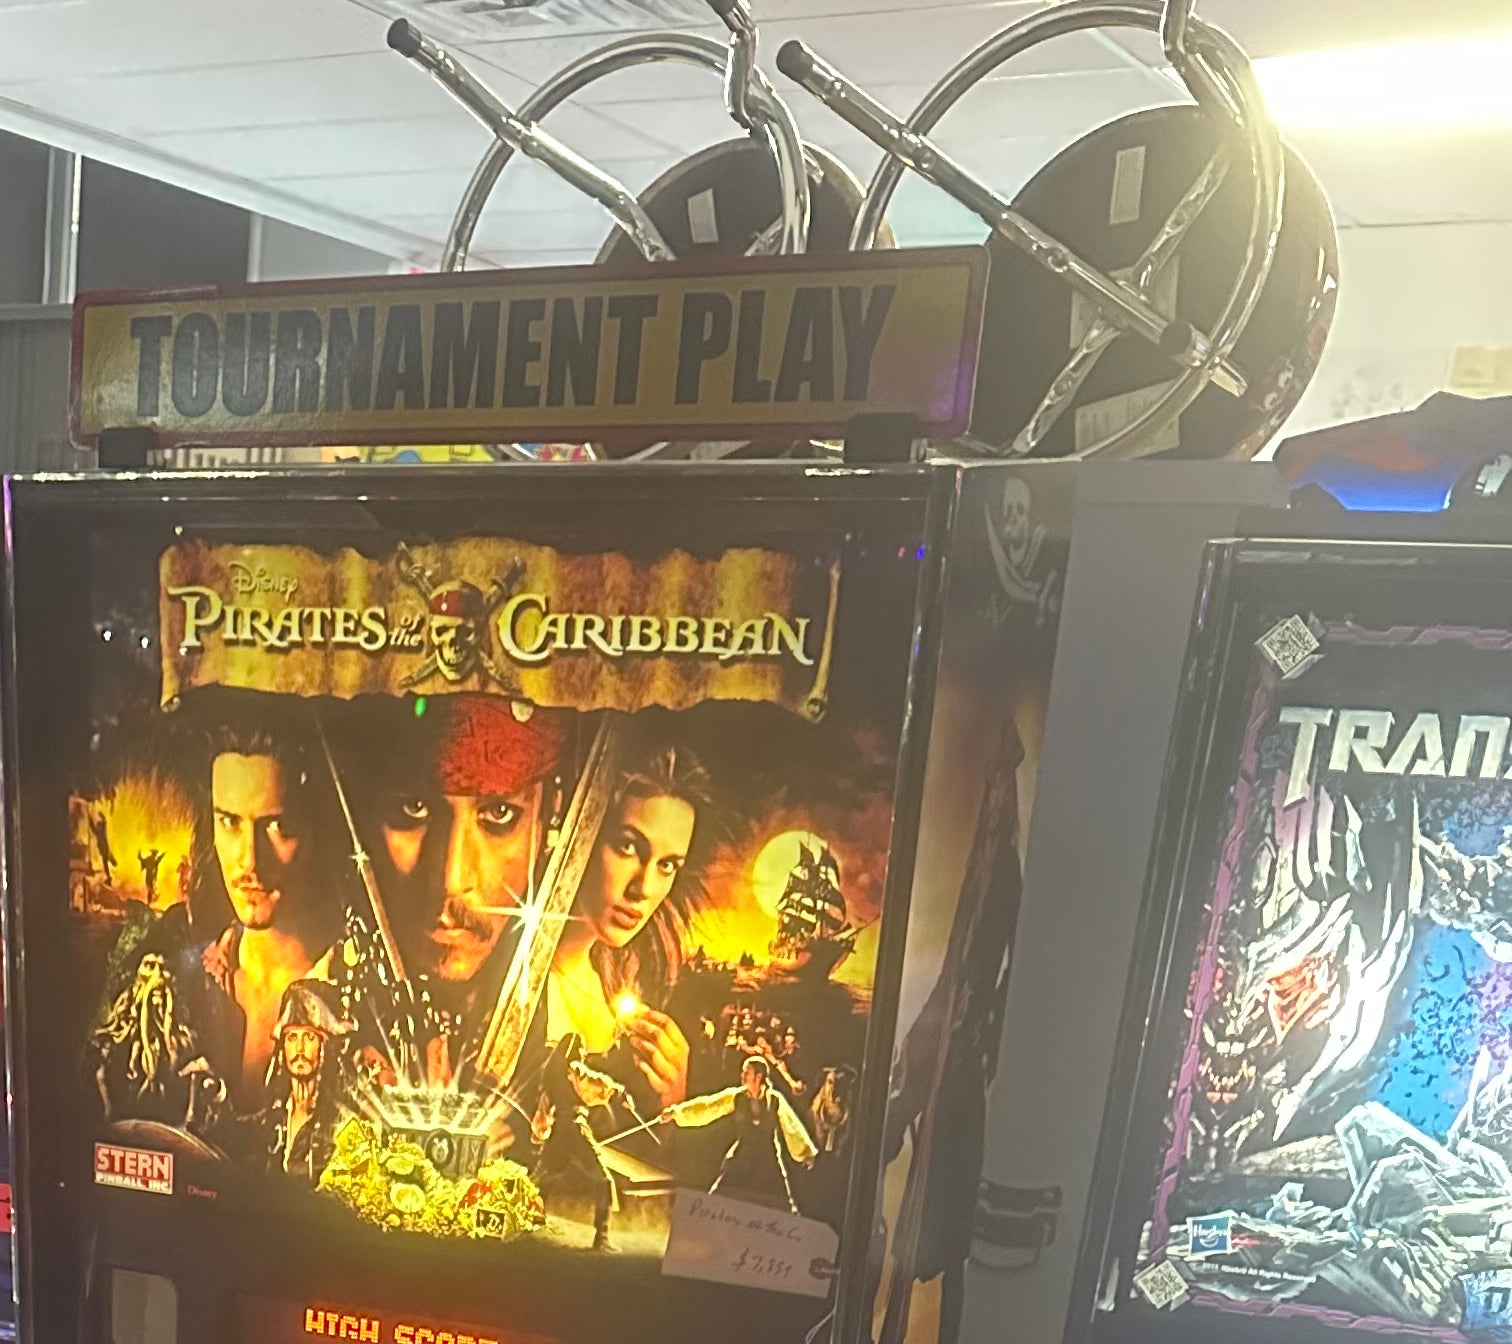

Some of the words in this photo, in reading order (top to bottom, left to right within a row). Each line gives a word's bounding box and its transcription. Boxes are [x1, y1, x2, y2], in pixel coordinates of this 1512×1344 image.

[130, 294, 658, 419] TOURNAMENT
[675, 284, 896, 406] PLAY
[168, 584, 387, 653] PIRATES
[389, 627, 425, 648] the
[497, 593, 814, 665] CARIBBEAN
[1278, 706, 1512, 807] TRAN
[97, 1147, 169, 1180] STERN
[305, 1307, 380, 1343] HIGH
